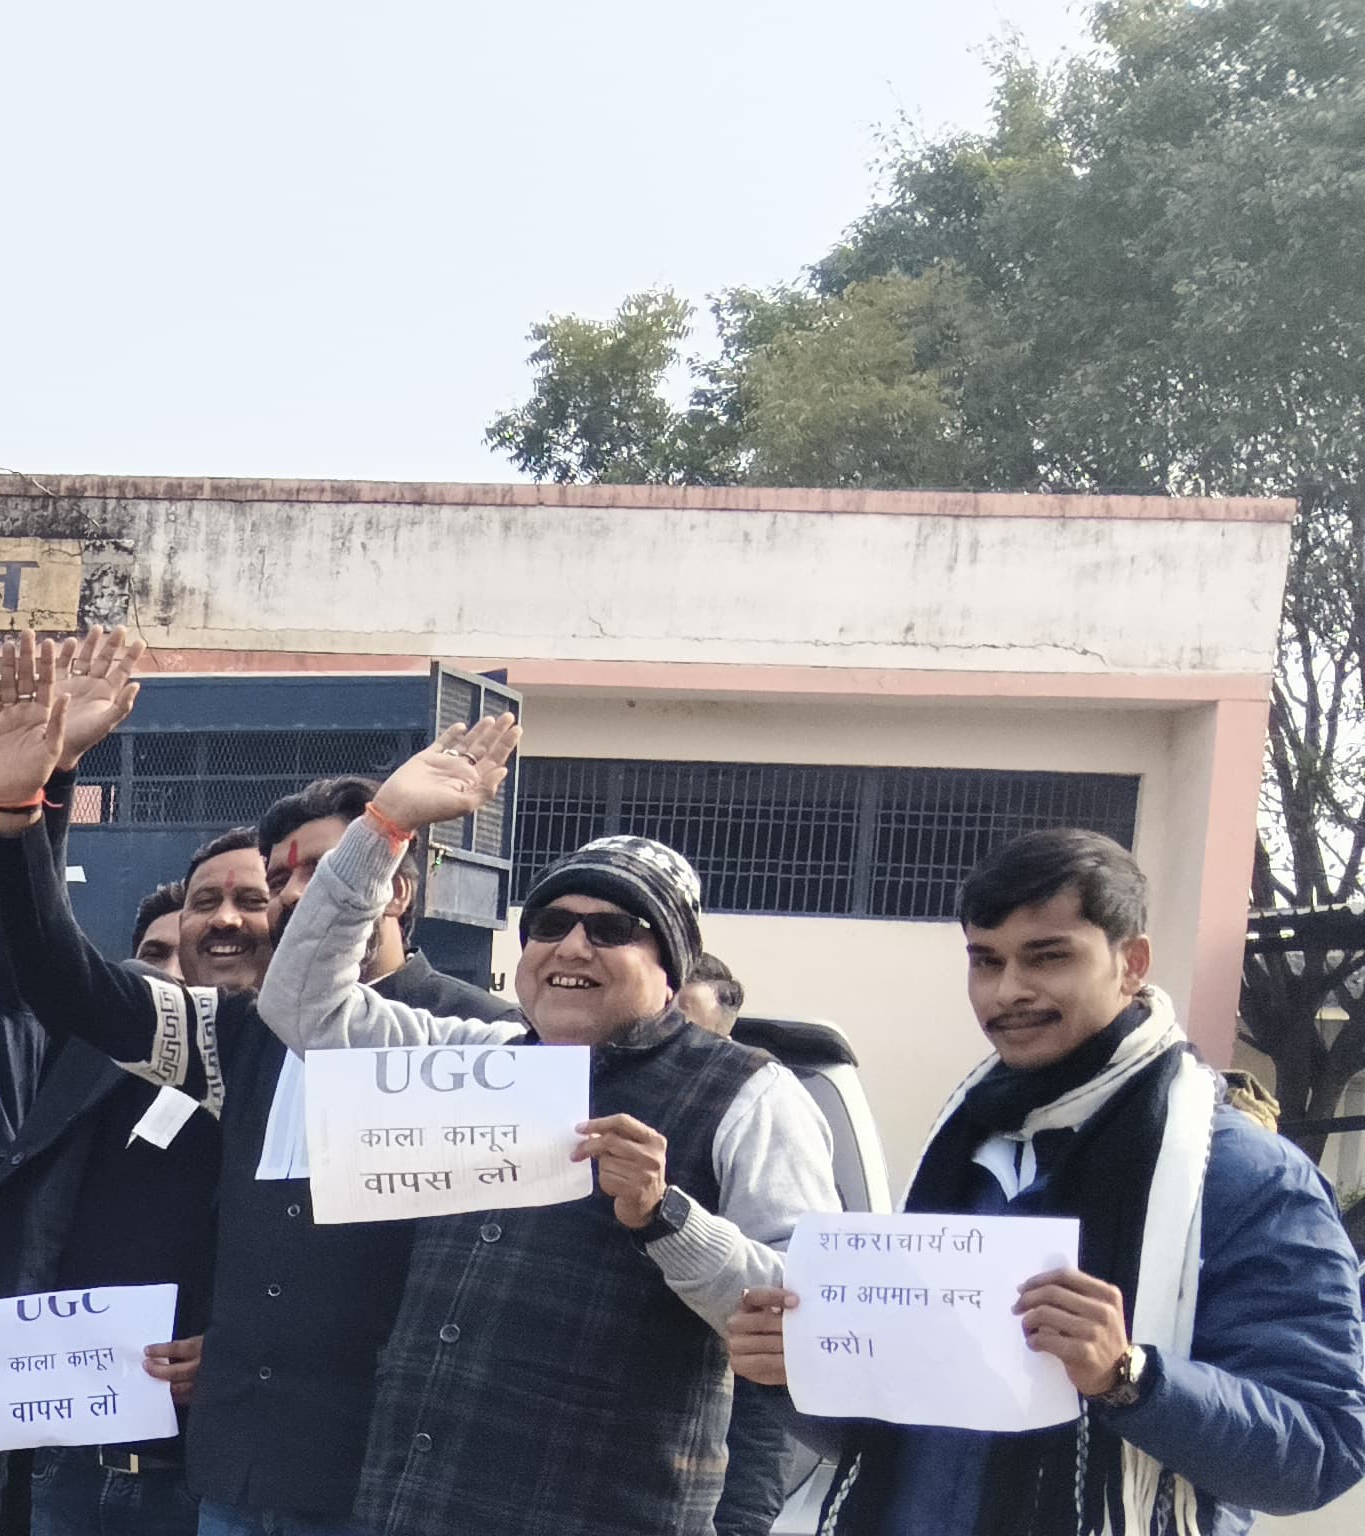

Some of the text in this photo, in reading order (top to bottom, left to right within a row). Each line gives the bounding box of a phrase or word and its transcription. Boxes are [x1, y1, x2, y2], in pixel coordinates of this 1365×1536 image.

[373, 1049, 517, 1094] UGC
[358, 1124, 521, 1152] काला कानून
[359, 1158, 522, 1195] वापस लो
[16, 1292, 111, 1322] UGC
[819, 1284, 985, 1309] का अपमान बन्द
[8, 1347, 115, 1373] काला कानून
[8, 1384, 120, 1423] वापस लो
